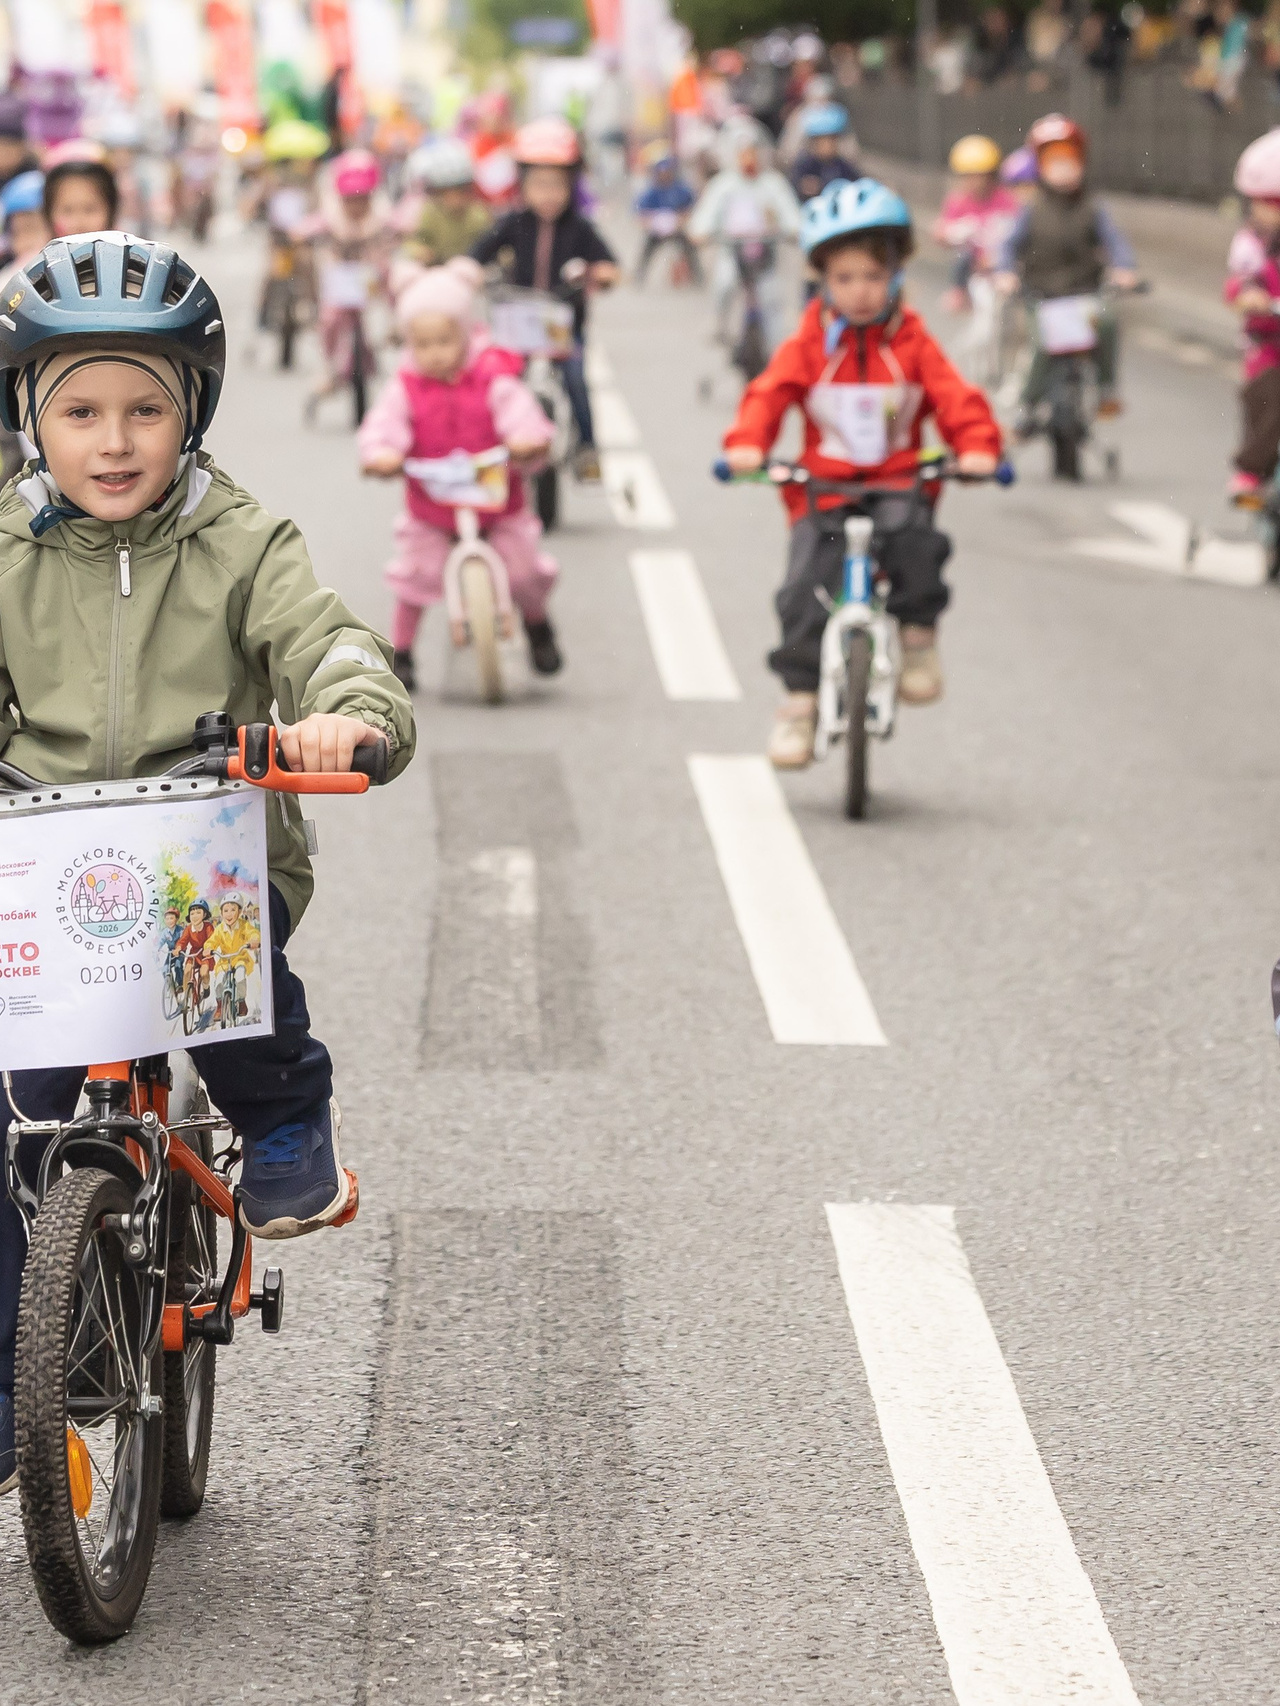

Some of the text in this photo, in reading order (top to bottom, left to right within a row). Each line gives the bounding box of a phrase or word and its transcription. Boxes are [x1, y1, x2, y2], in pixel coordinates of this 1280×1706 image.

[57, 848, 157, 892] МОСКОВСКИЙ
[55, 898, 160, 954] ВЕЛОФЕСТИВАЛЬ
[98, 924, 119, 933] 2026
[80, 963, 143, 985] 02019
